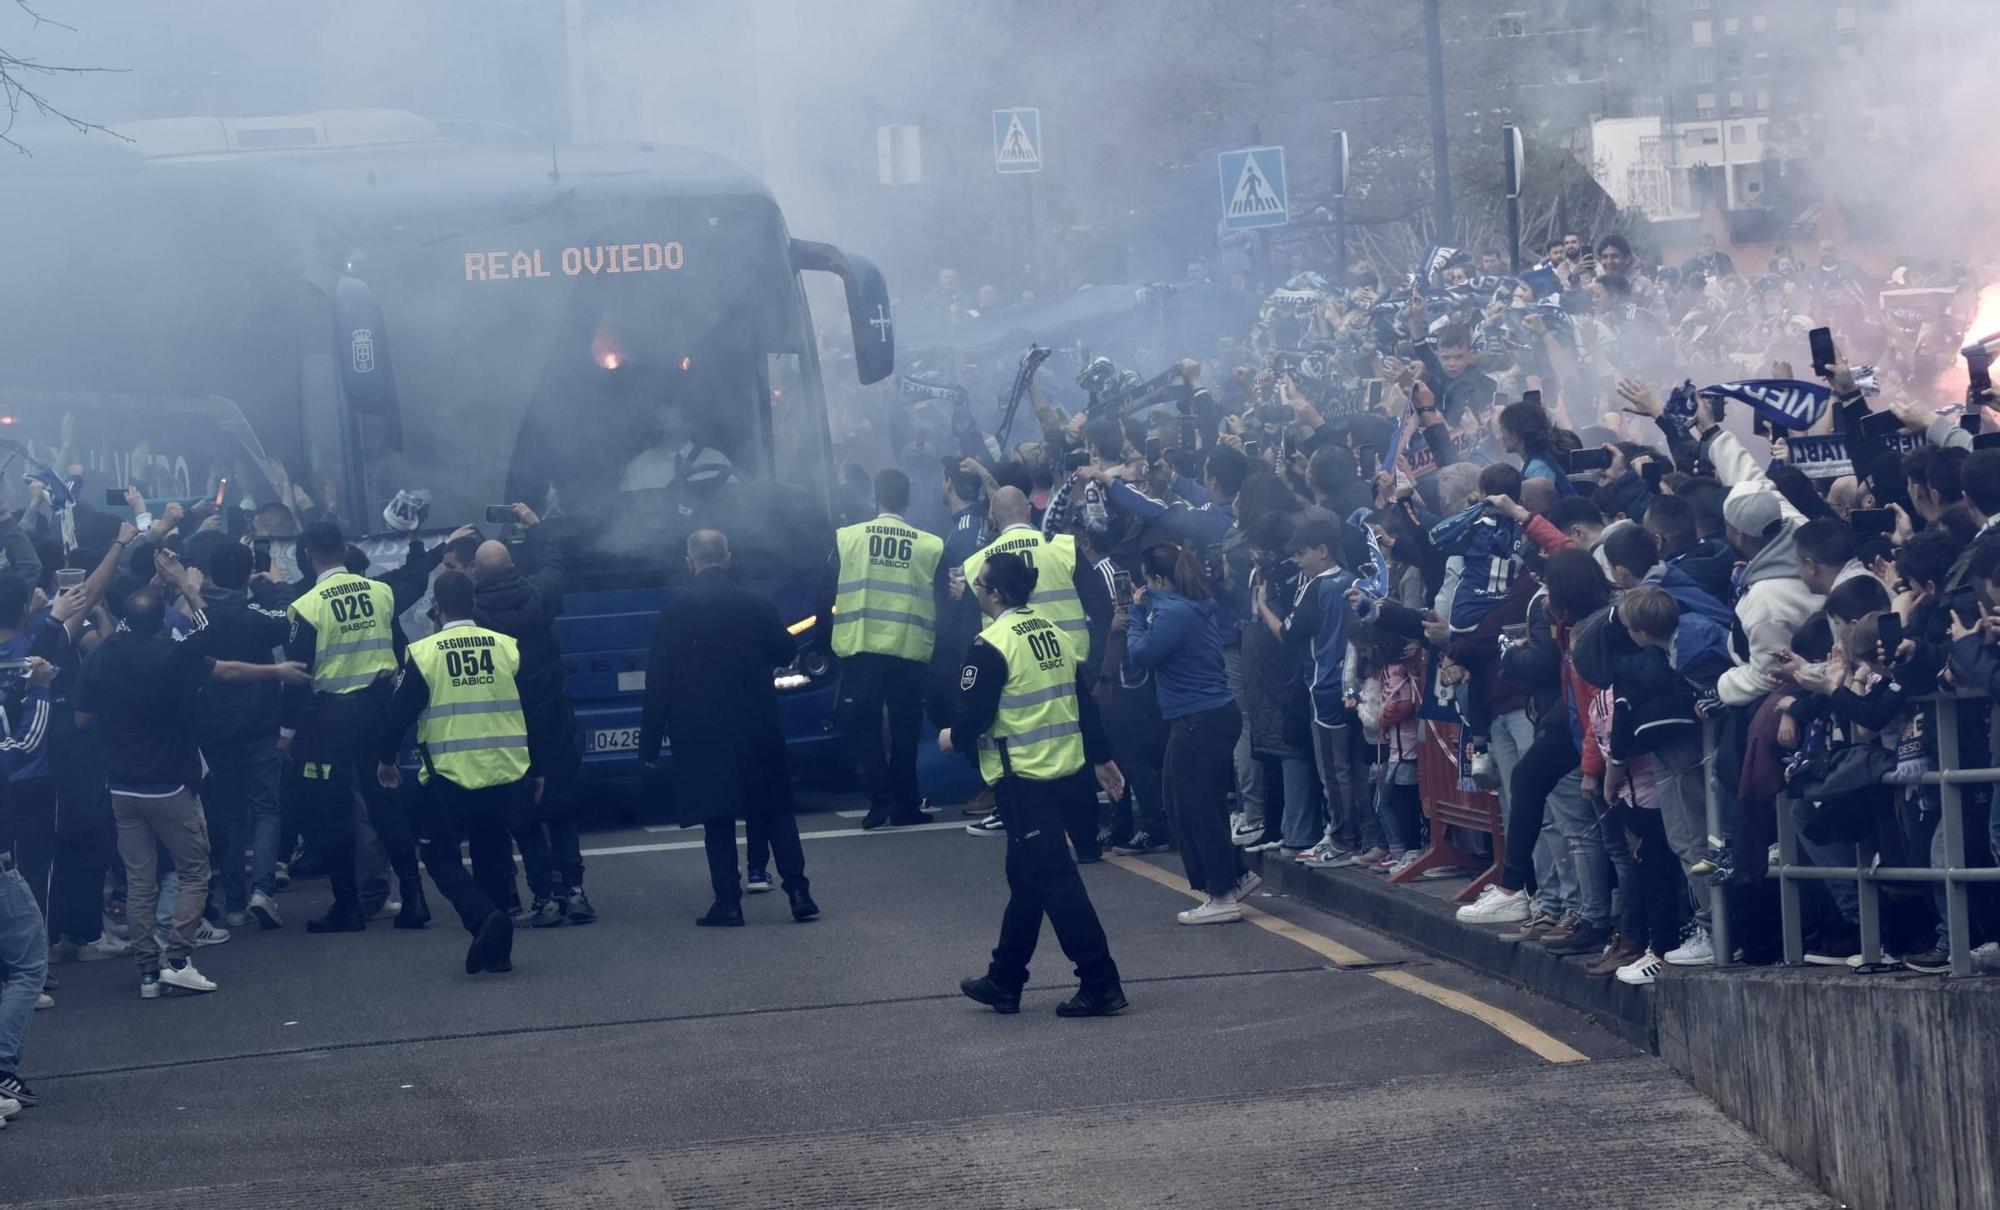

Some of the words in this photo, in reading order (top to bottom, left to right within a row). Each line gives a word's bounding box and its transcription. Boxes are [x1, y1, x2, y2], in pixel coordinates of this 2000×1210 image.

[465, 250, 551, 280] REAL
[562, 242, 684, 275] OVIEDO
[865, 525, 918, 539] SEGURIDAD
[869, 535, 912, 561] 006
[870, 558, 910, 569] SABICO
[319, 581, 371, 600] SEGURIDAD
[331, 592, 374, 623] 026
[341, 620, 376, 634] SABICO
[436, 636, 496, 650] SEGURIDAD
[1027, 630, 1061, 661] 016
[445, 649, 495, 677] 054
[452, 676, 494, 687] SABICO
[597, 730, 640, 749] 0428
